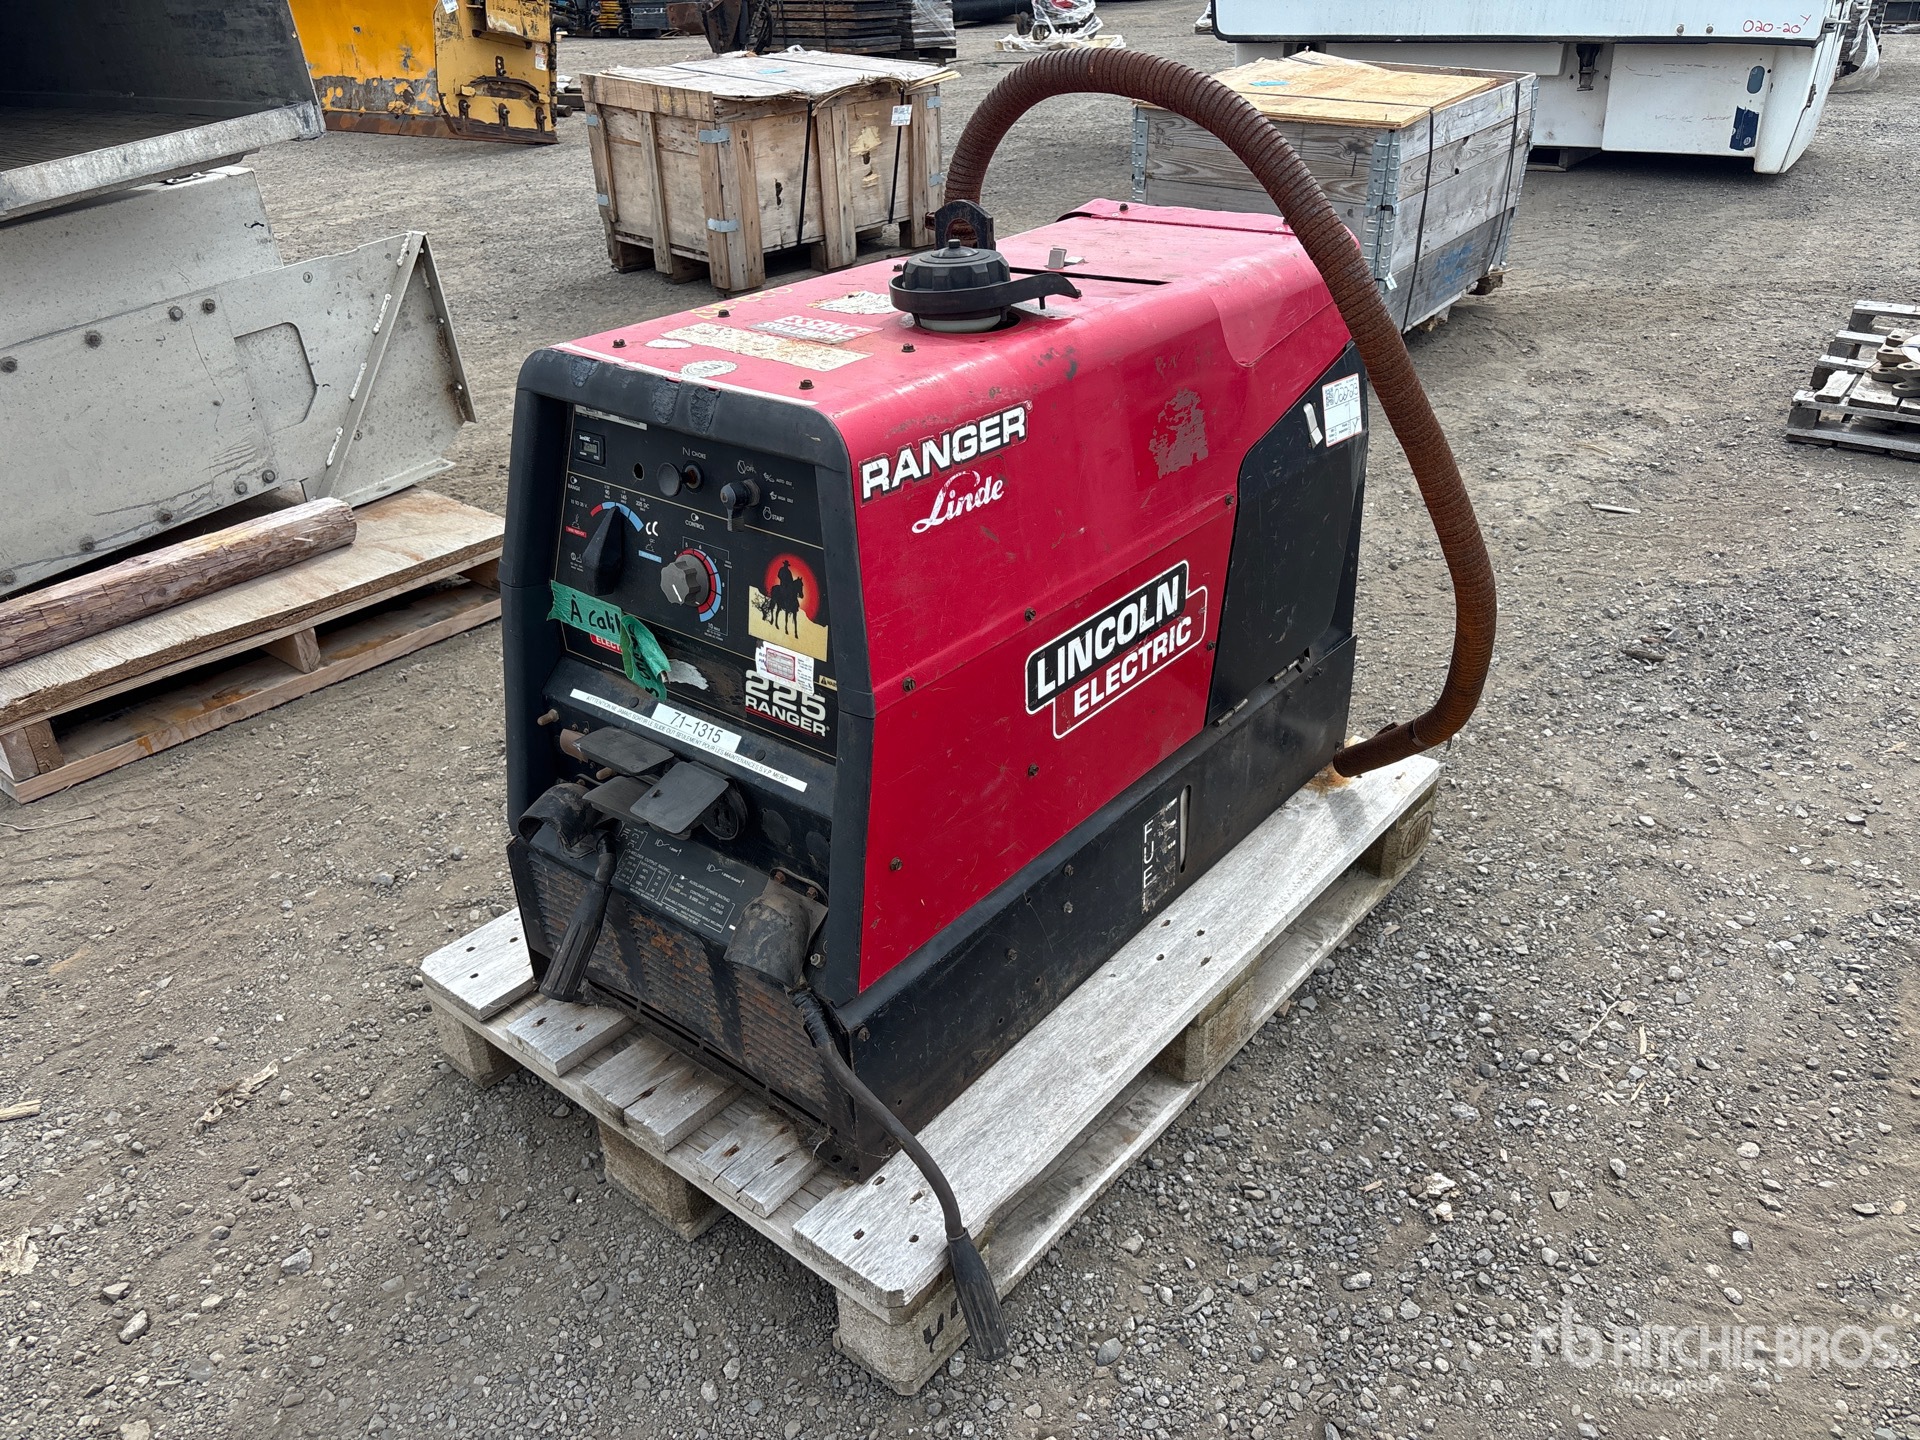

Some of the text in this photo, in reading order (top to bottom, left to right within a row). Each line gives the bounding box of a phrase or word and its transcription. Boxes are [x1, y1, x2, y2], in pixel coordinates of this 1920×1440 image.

[1742, 19, 1801, 34] 020-20
[691, 450, 706, 460] CHOKE
[862, 406, 1026, 499] RANGER
[568, 483, 580, 492] RANGE
[911, 470, 1005, 534] Linde
[684, 519, 705, 530] CONTROL
[772, 514, 784, 522] START
[1037, 575, 1180, 700] LINCOLN
[1073, 616, 1192, 717] ELECTRIC
[746, 670, 826, 721] 225
[746, 694, 826, 737] RANGER
[616, 706, 632, 718] JAMAIS
[632, 712, 648, 724] SORTIR
[648, 718, 654, 726] LE
[654, 721, 666, 732] SLIDE
[666, 726, 676, 736] OUT
[676, 730, 702, 746] SEULEMENT
[702, 741, 716, 750] POUR
[715, 746, 724, 755] LES
[724, 750, 759, 770] MAINTENANCES
[772, 772, 788, 782] MERCI
[670, 712, 724, 744] 71-1315
